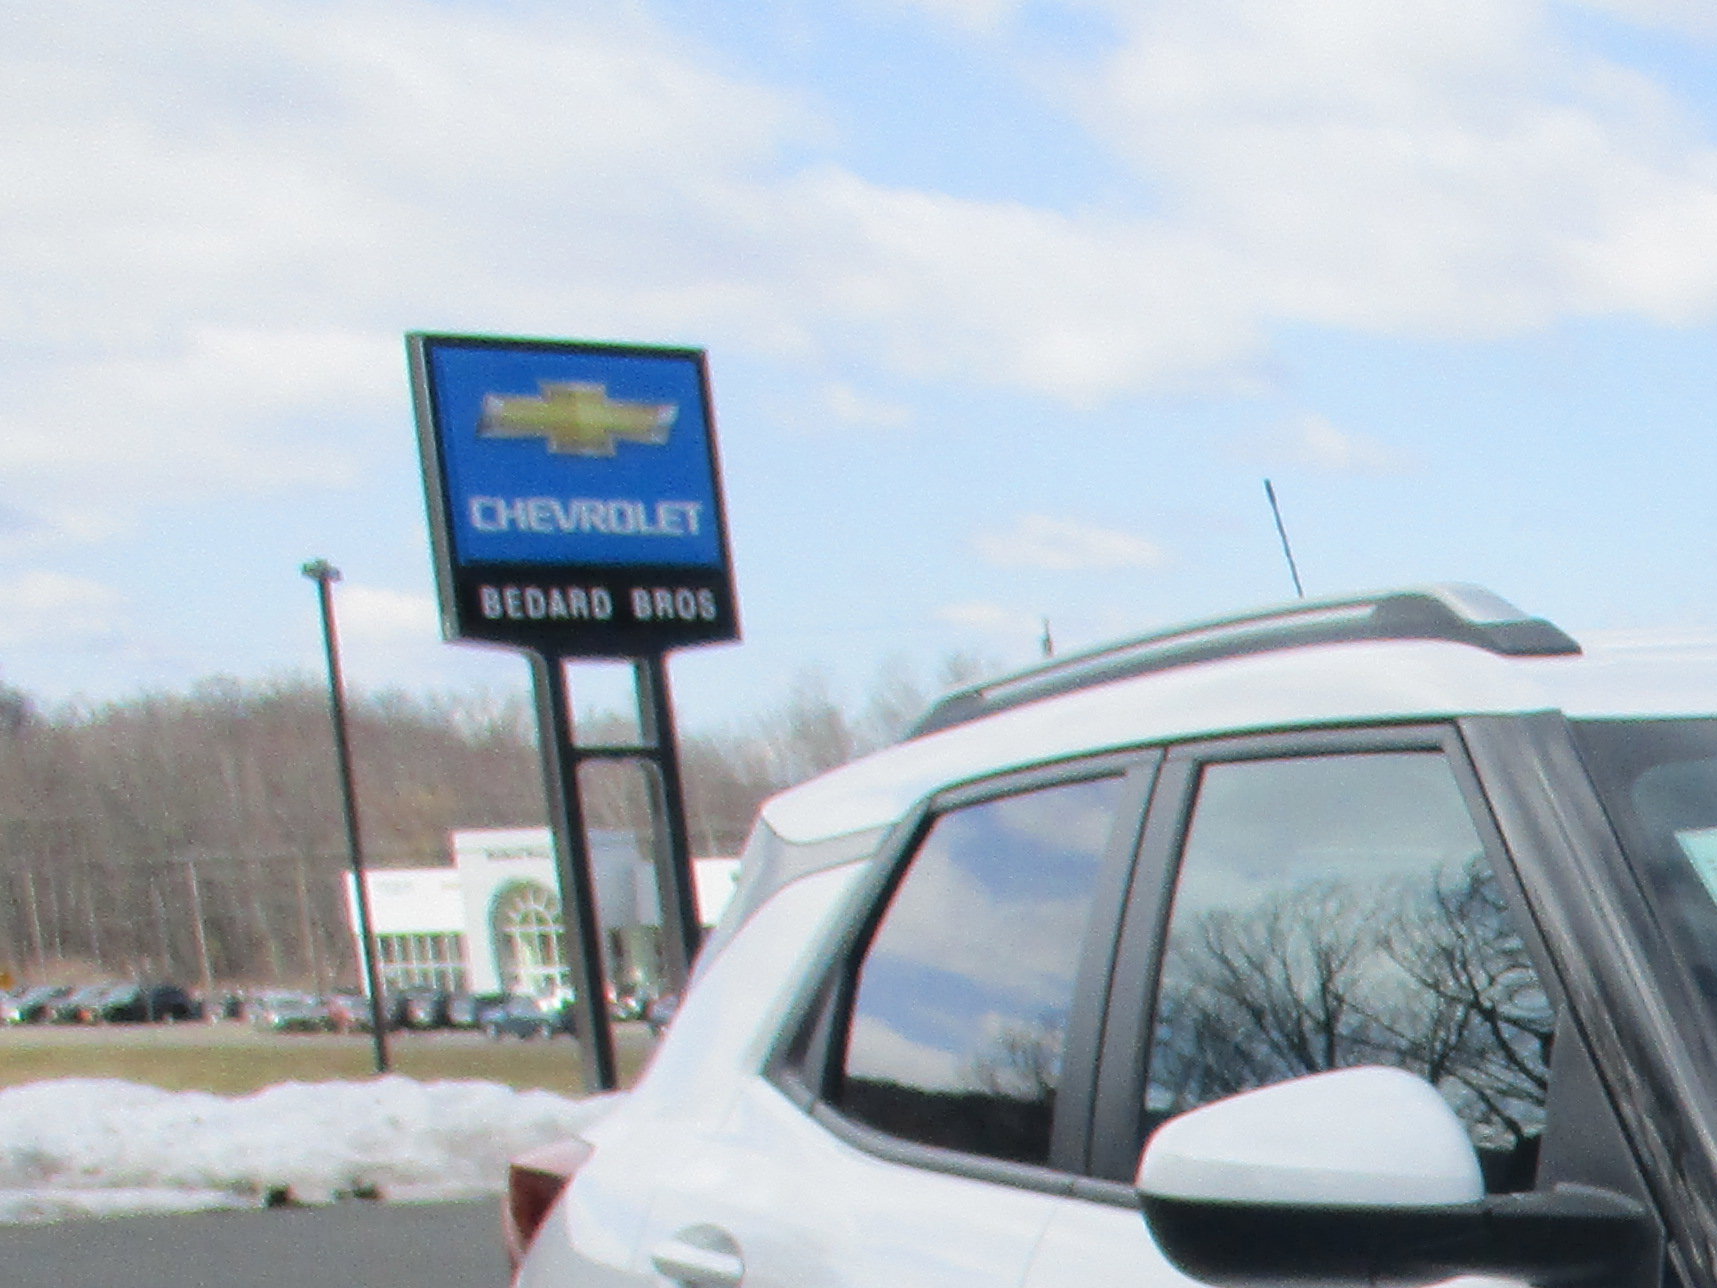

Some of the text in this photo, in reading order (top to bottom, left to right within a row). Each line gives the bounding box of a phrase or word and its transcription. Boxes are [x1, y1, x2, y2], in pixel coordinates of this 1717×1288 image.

[470, 496, 702, 536] CHEVROLET
[480, 585, 717, 621] BEDARD BROS
